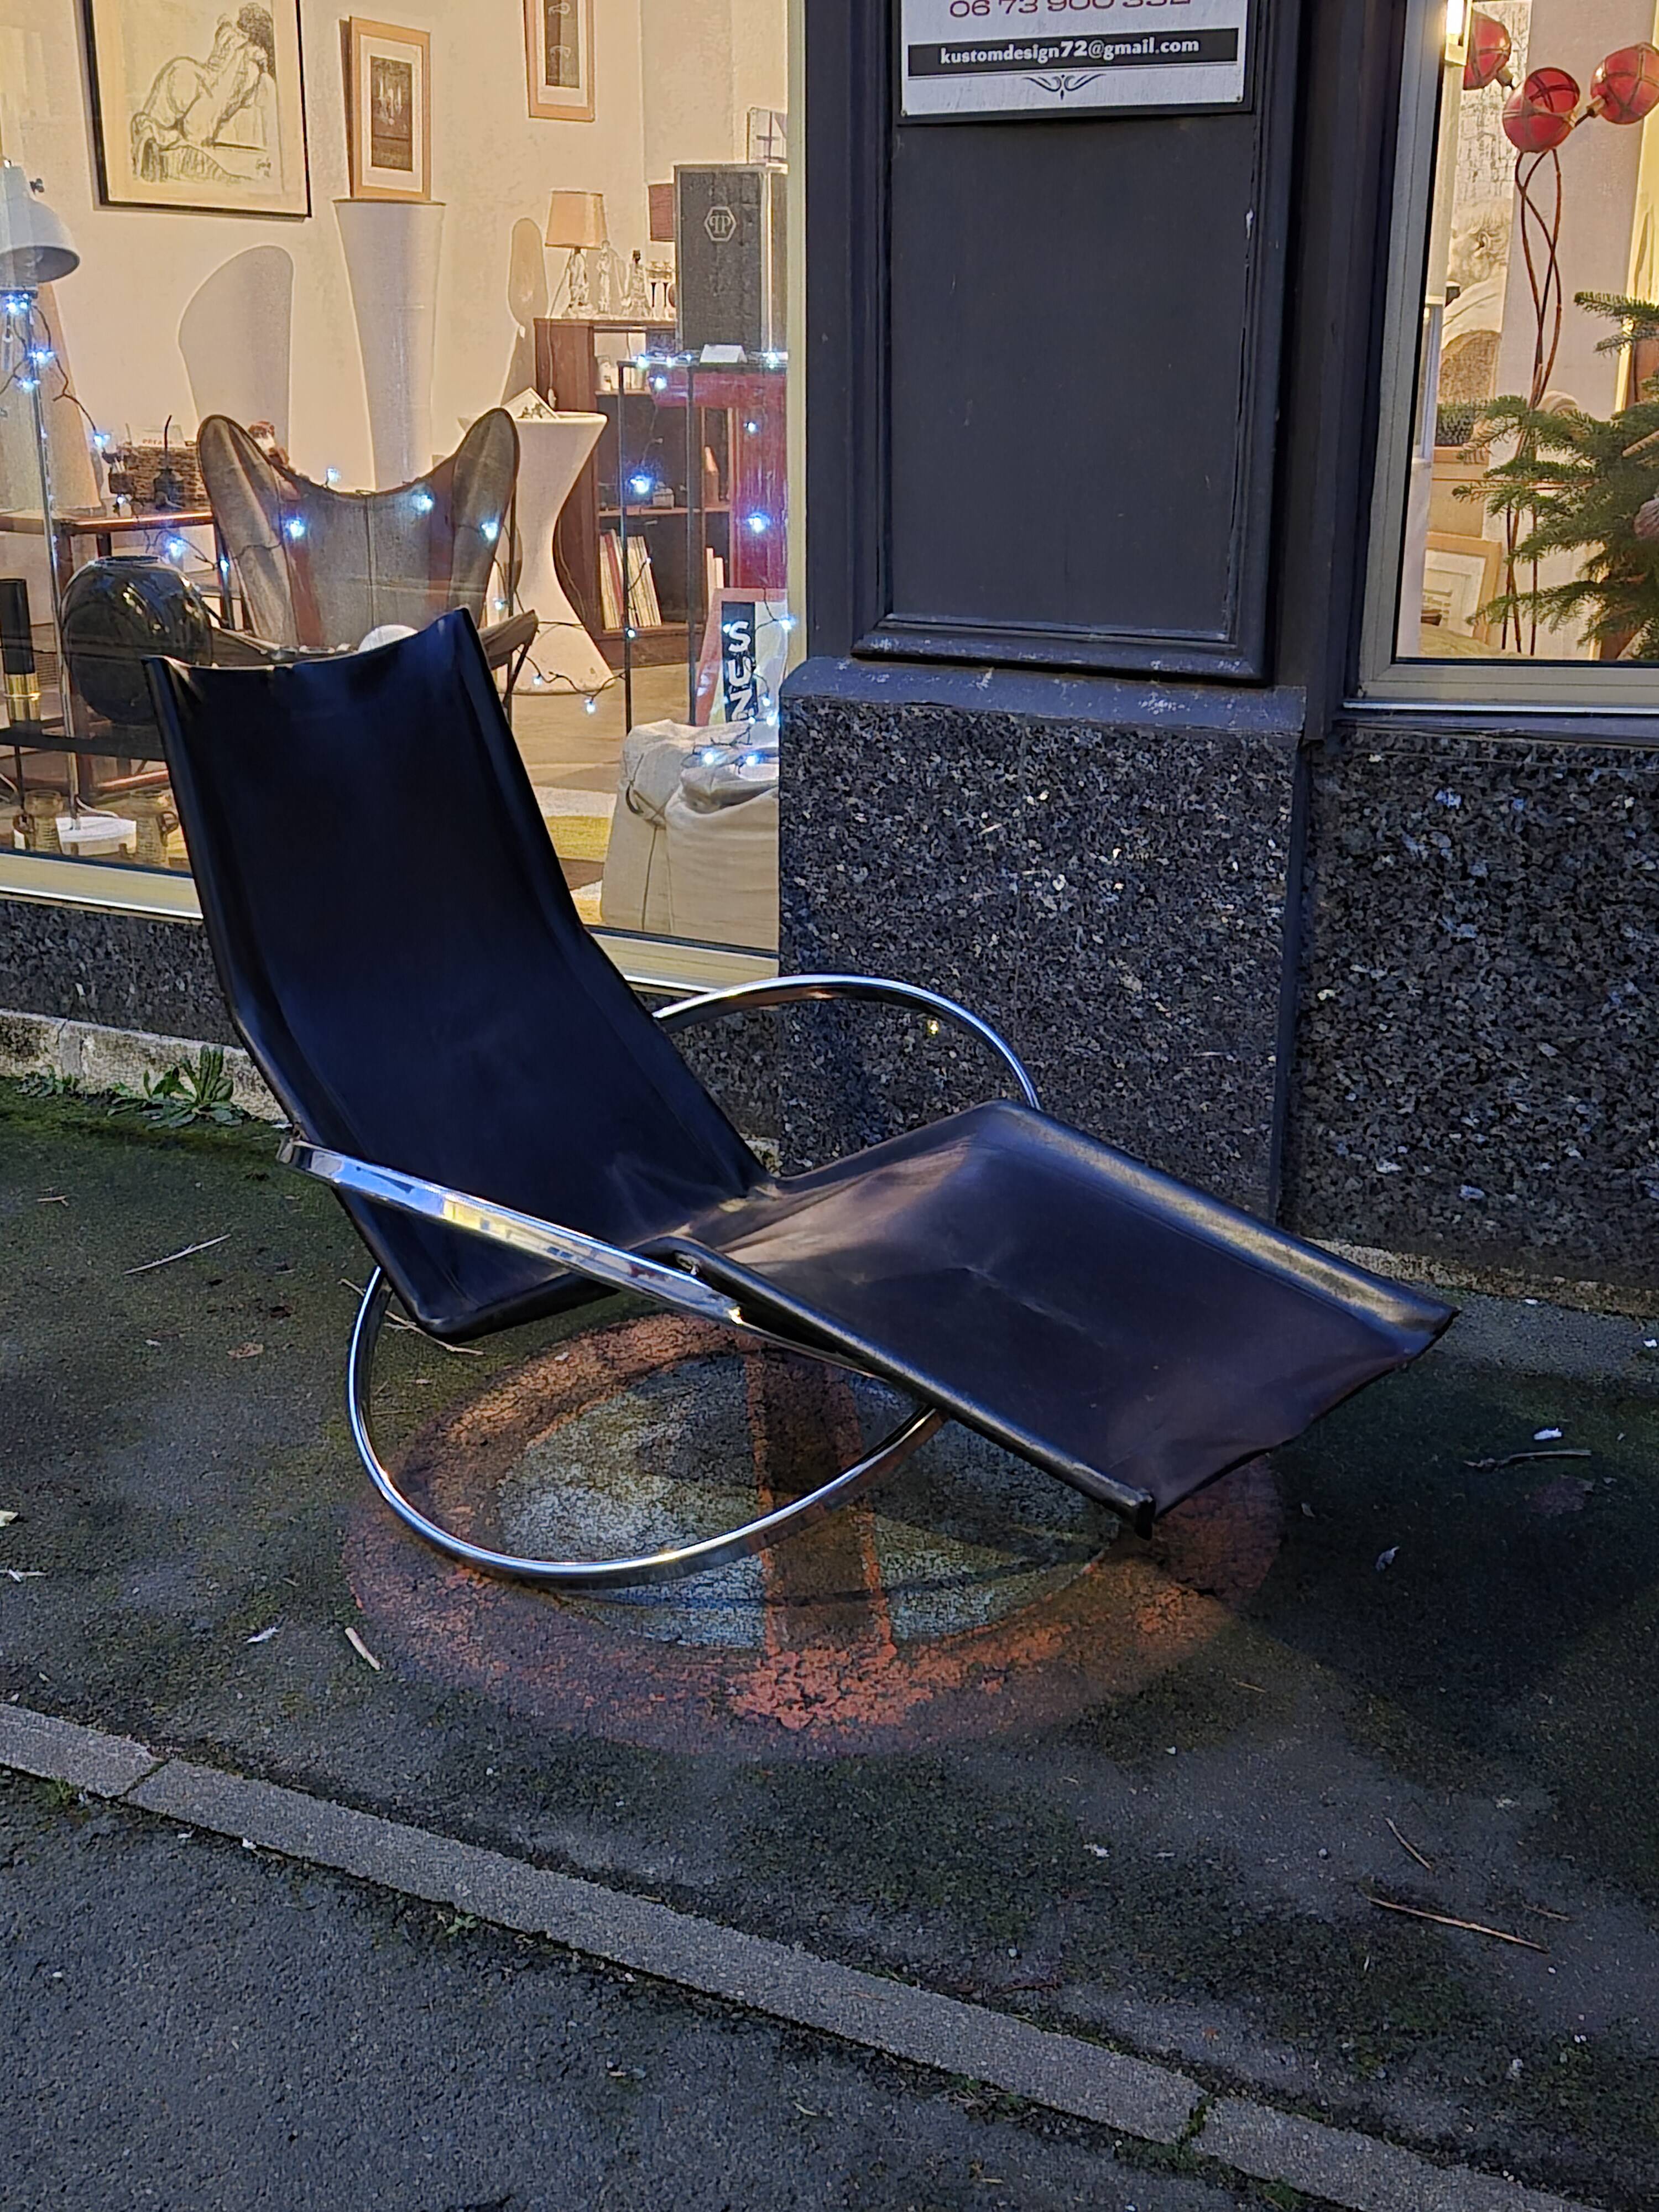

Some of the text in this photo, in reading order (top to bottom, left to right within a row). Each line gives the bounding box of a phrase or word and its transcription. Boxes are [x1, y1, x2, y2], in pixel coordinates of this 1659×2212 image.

[950, 0, 990, 17] 06
[998, 0, 1038, 14] 73
[941, 37, 1199, 64] kustomdesign72@gmail.com
